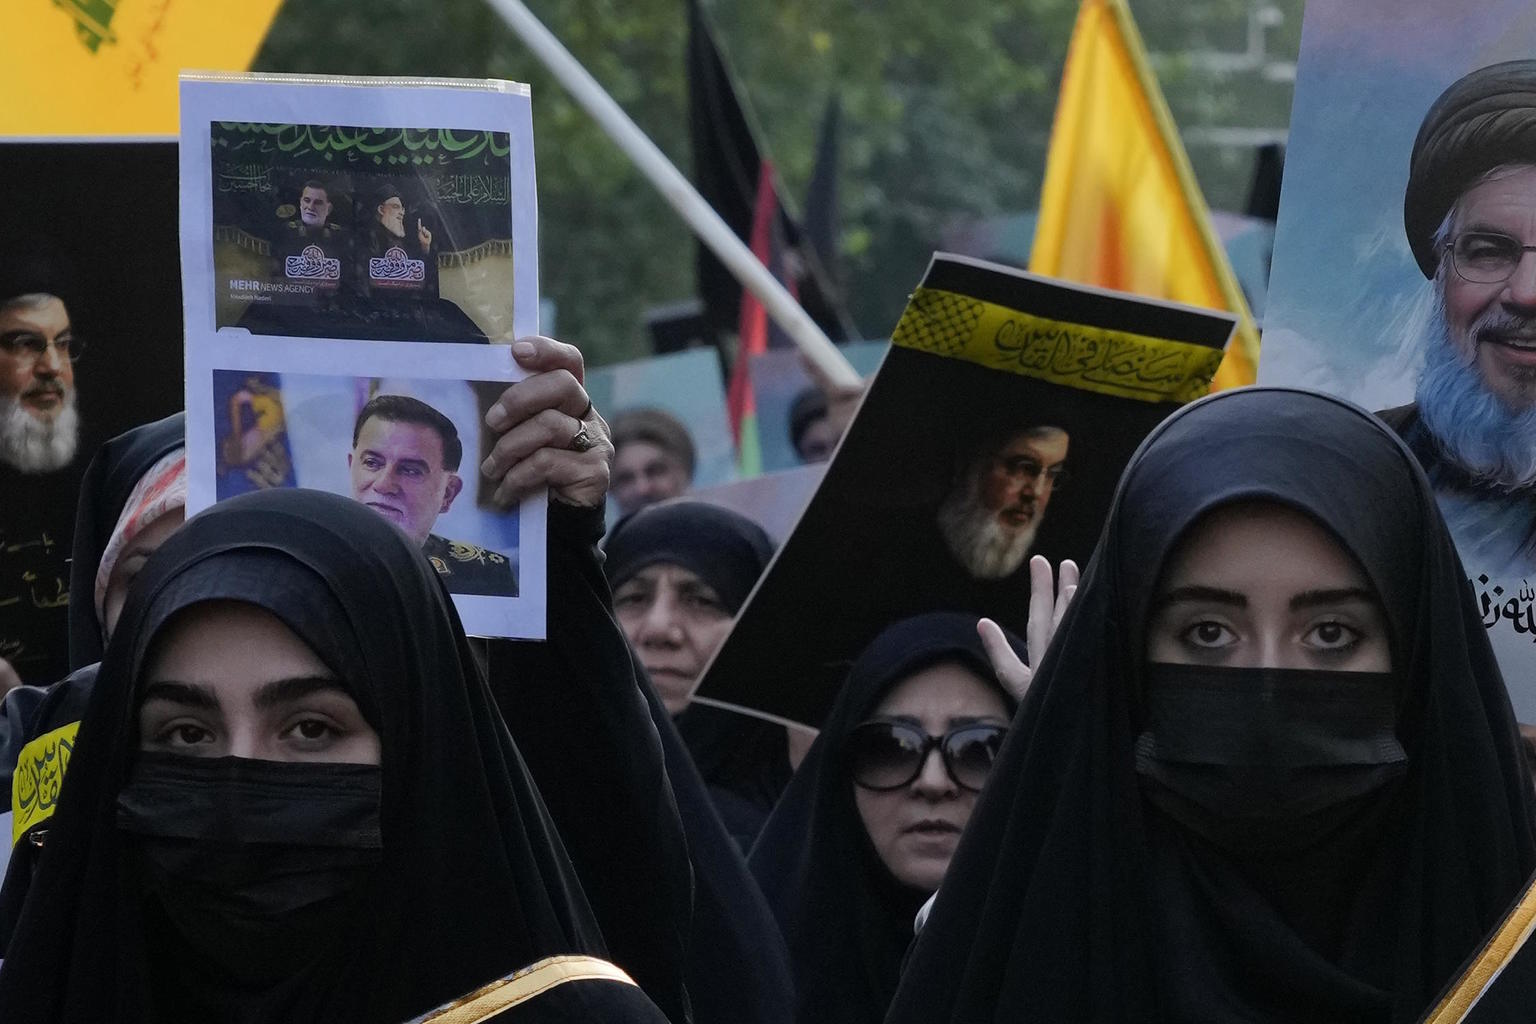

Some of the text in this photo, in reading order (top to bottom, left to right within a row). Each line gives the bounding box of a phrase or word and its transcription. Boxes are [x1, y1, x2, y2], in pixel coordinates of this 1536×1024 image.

[229, 279, 260, 291] MEHR
[260, 282, 283, 293] NEWS
[284, 285, 314, 295] AGENCY
